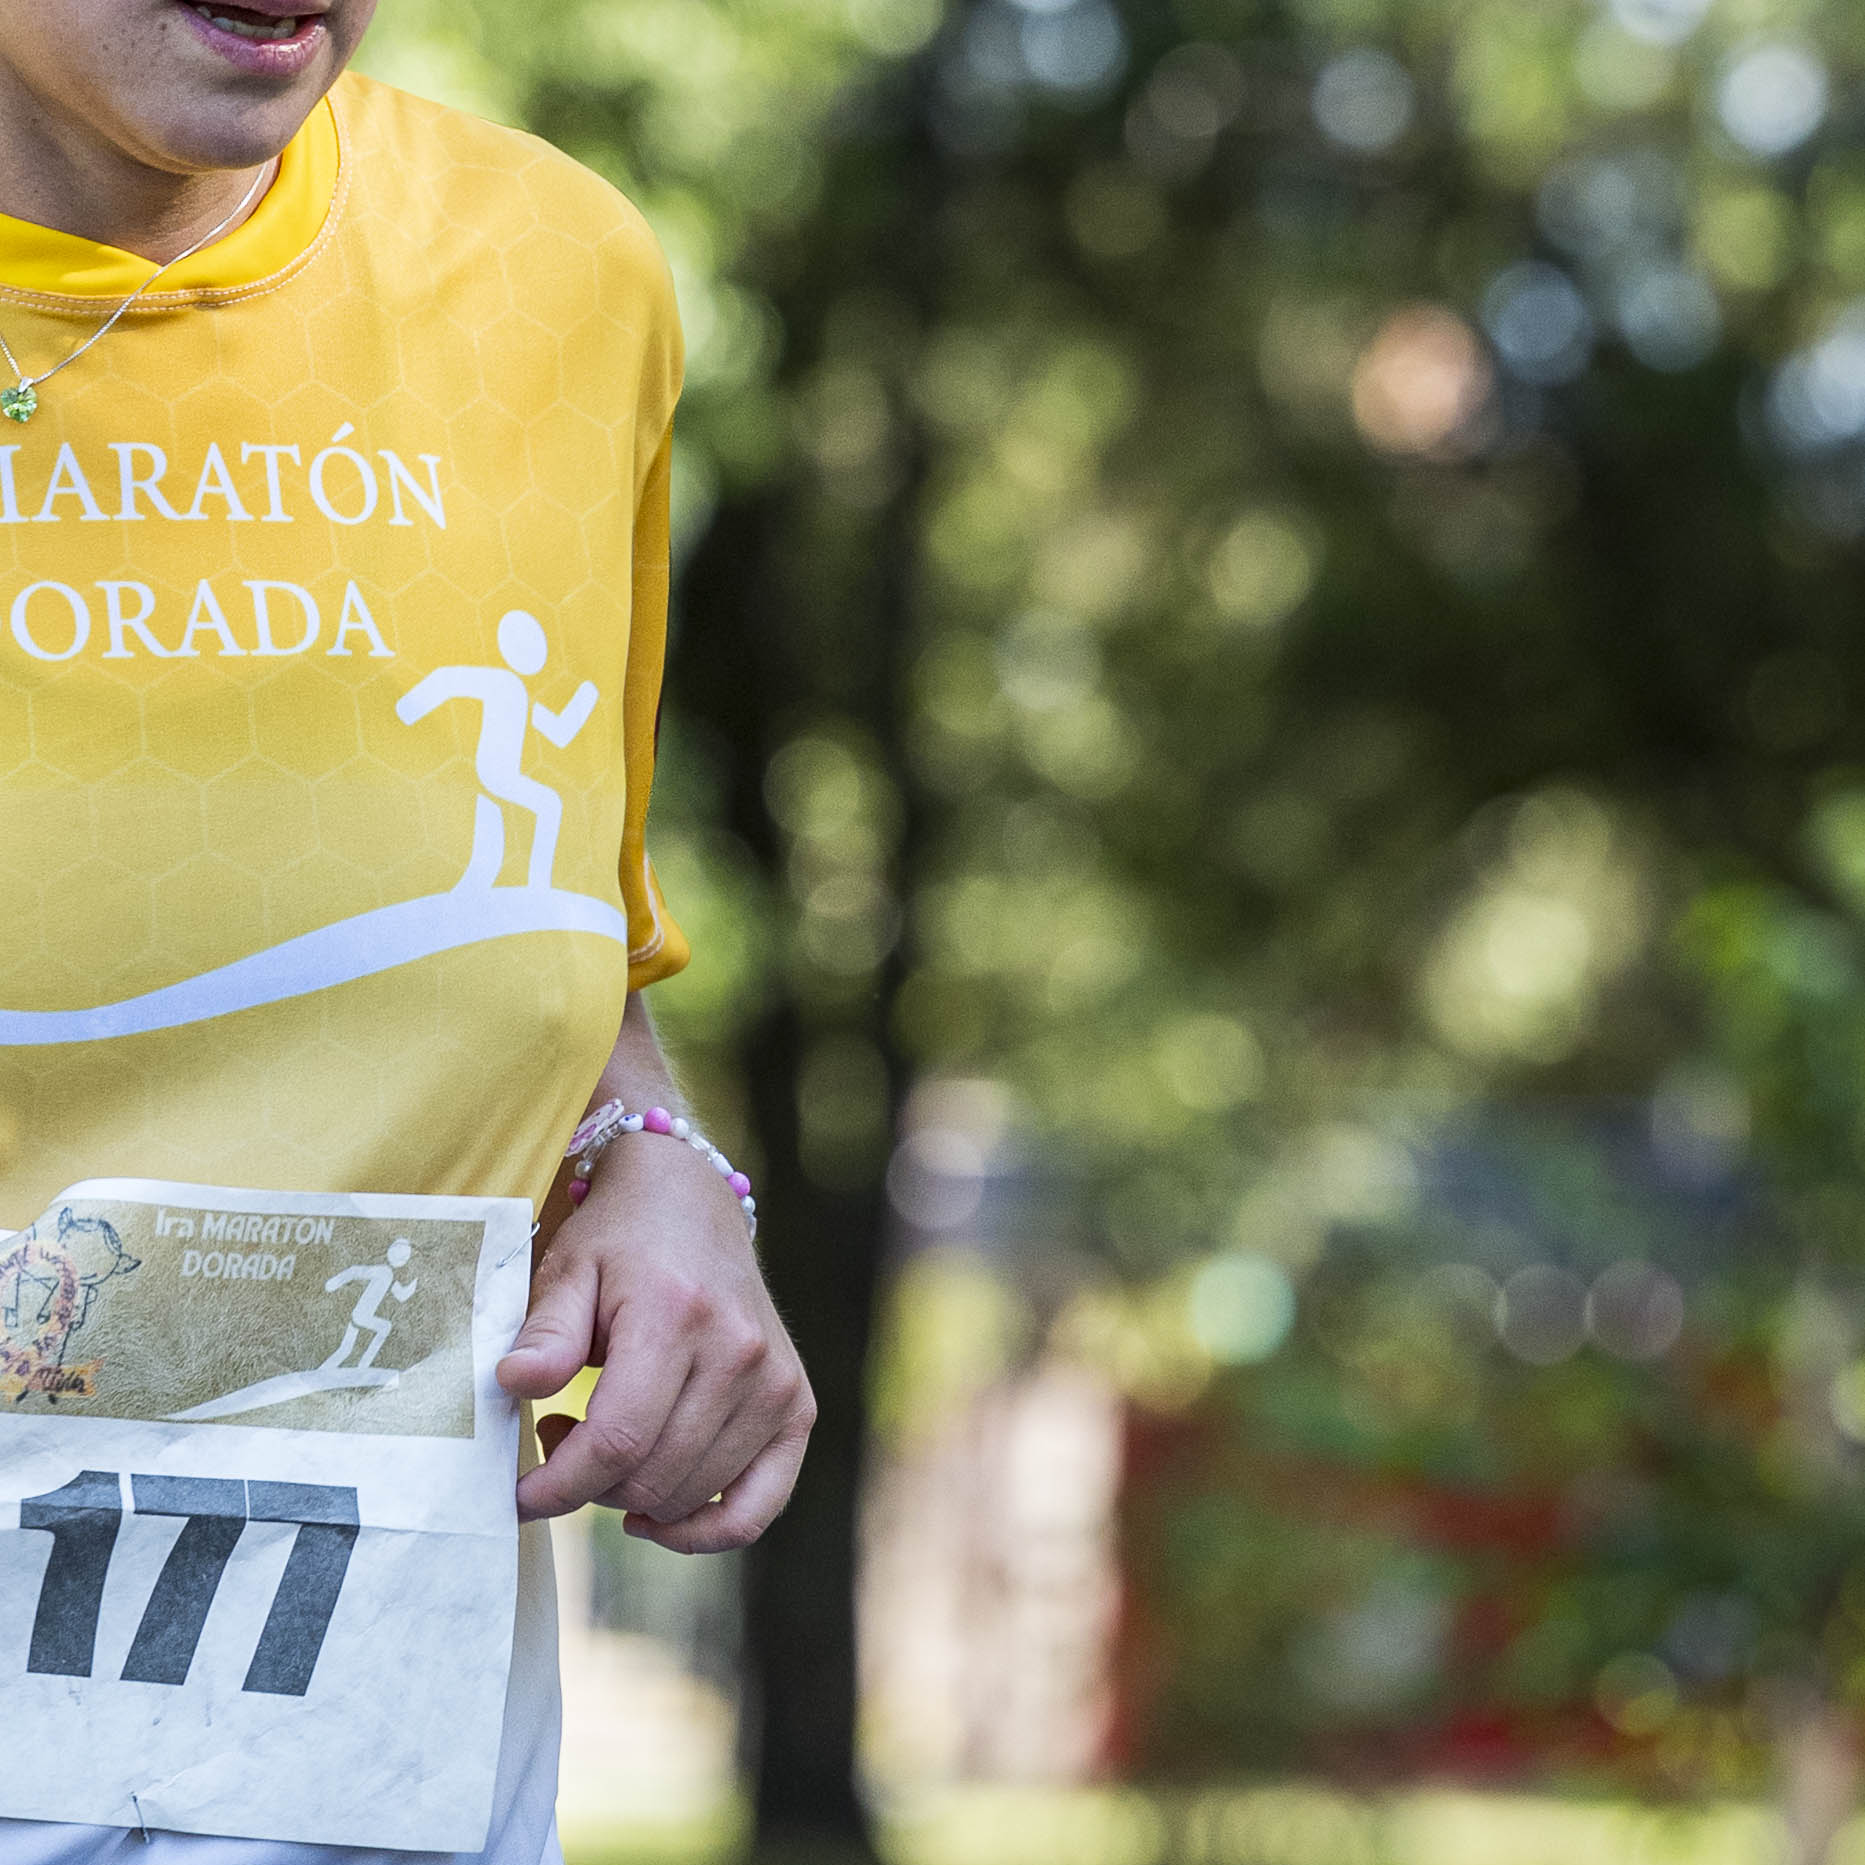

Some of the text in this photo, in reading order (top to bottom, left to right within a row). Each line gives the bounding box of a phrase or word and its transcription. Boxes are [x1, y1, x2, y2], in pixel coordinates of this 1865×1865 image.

[201, 1212, 336, 1245] MARATON
[181, 1249, 297, 1281] DORADA
[20, 1470, 361, 1697] 177
